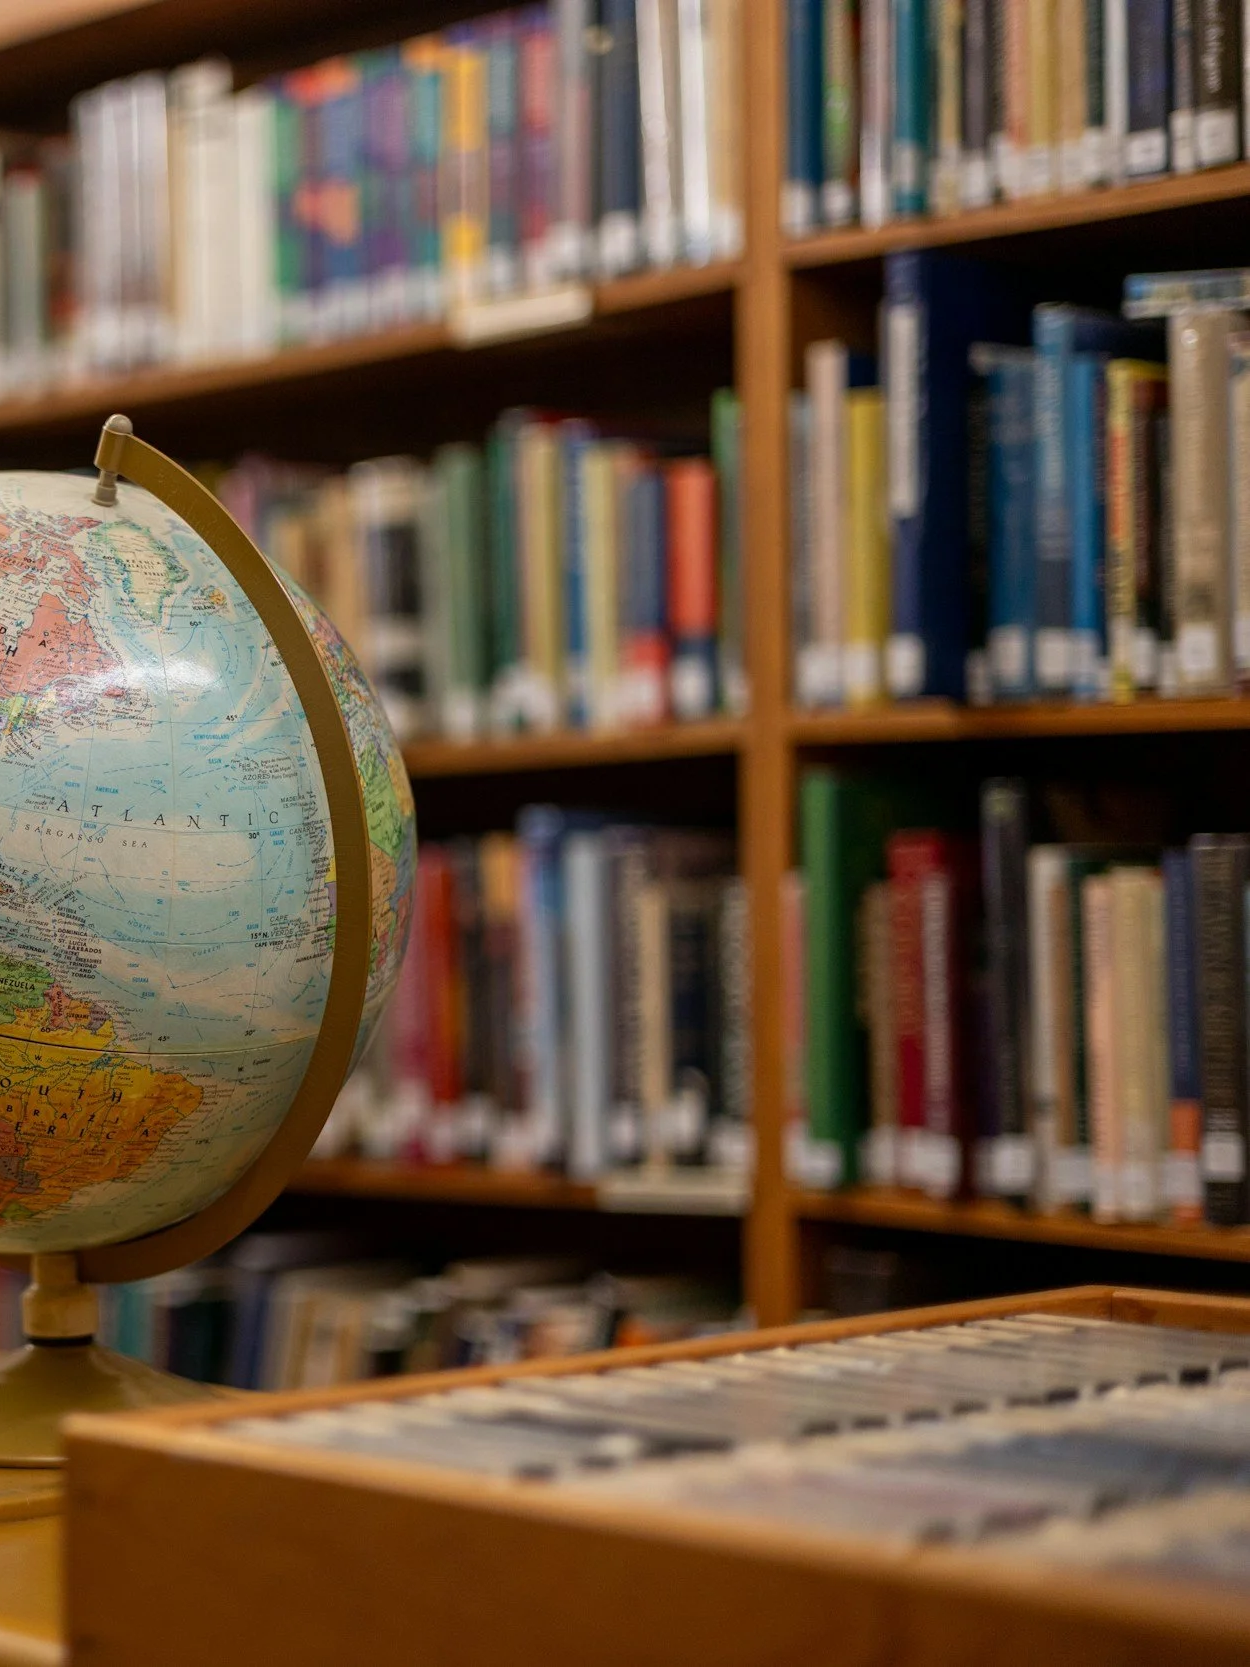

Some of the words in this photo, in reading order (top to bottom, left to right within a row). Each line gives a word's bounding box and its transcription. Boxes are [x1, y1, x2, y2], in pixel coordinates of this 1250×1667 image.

[243, 773, 271, 781] AZORES
[56, 799, 280, 830] ATLANTIC
[24, 823, 104, 844] SARGASSO
[122, 840, 148, 848] SEA
[57, 928, 88, 937] DOMINICA
[67, 945, 102, 954] BARBADOS
